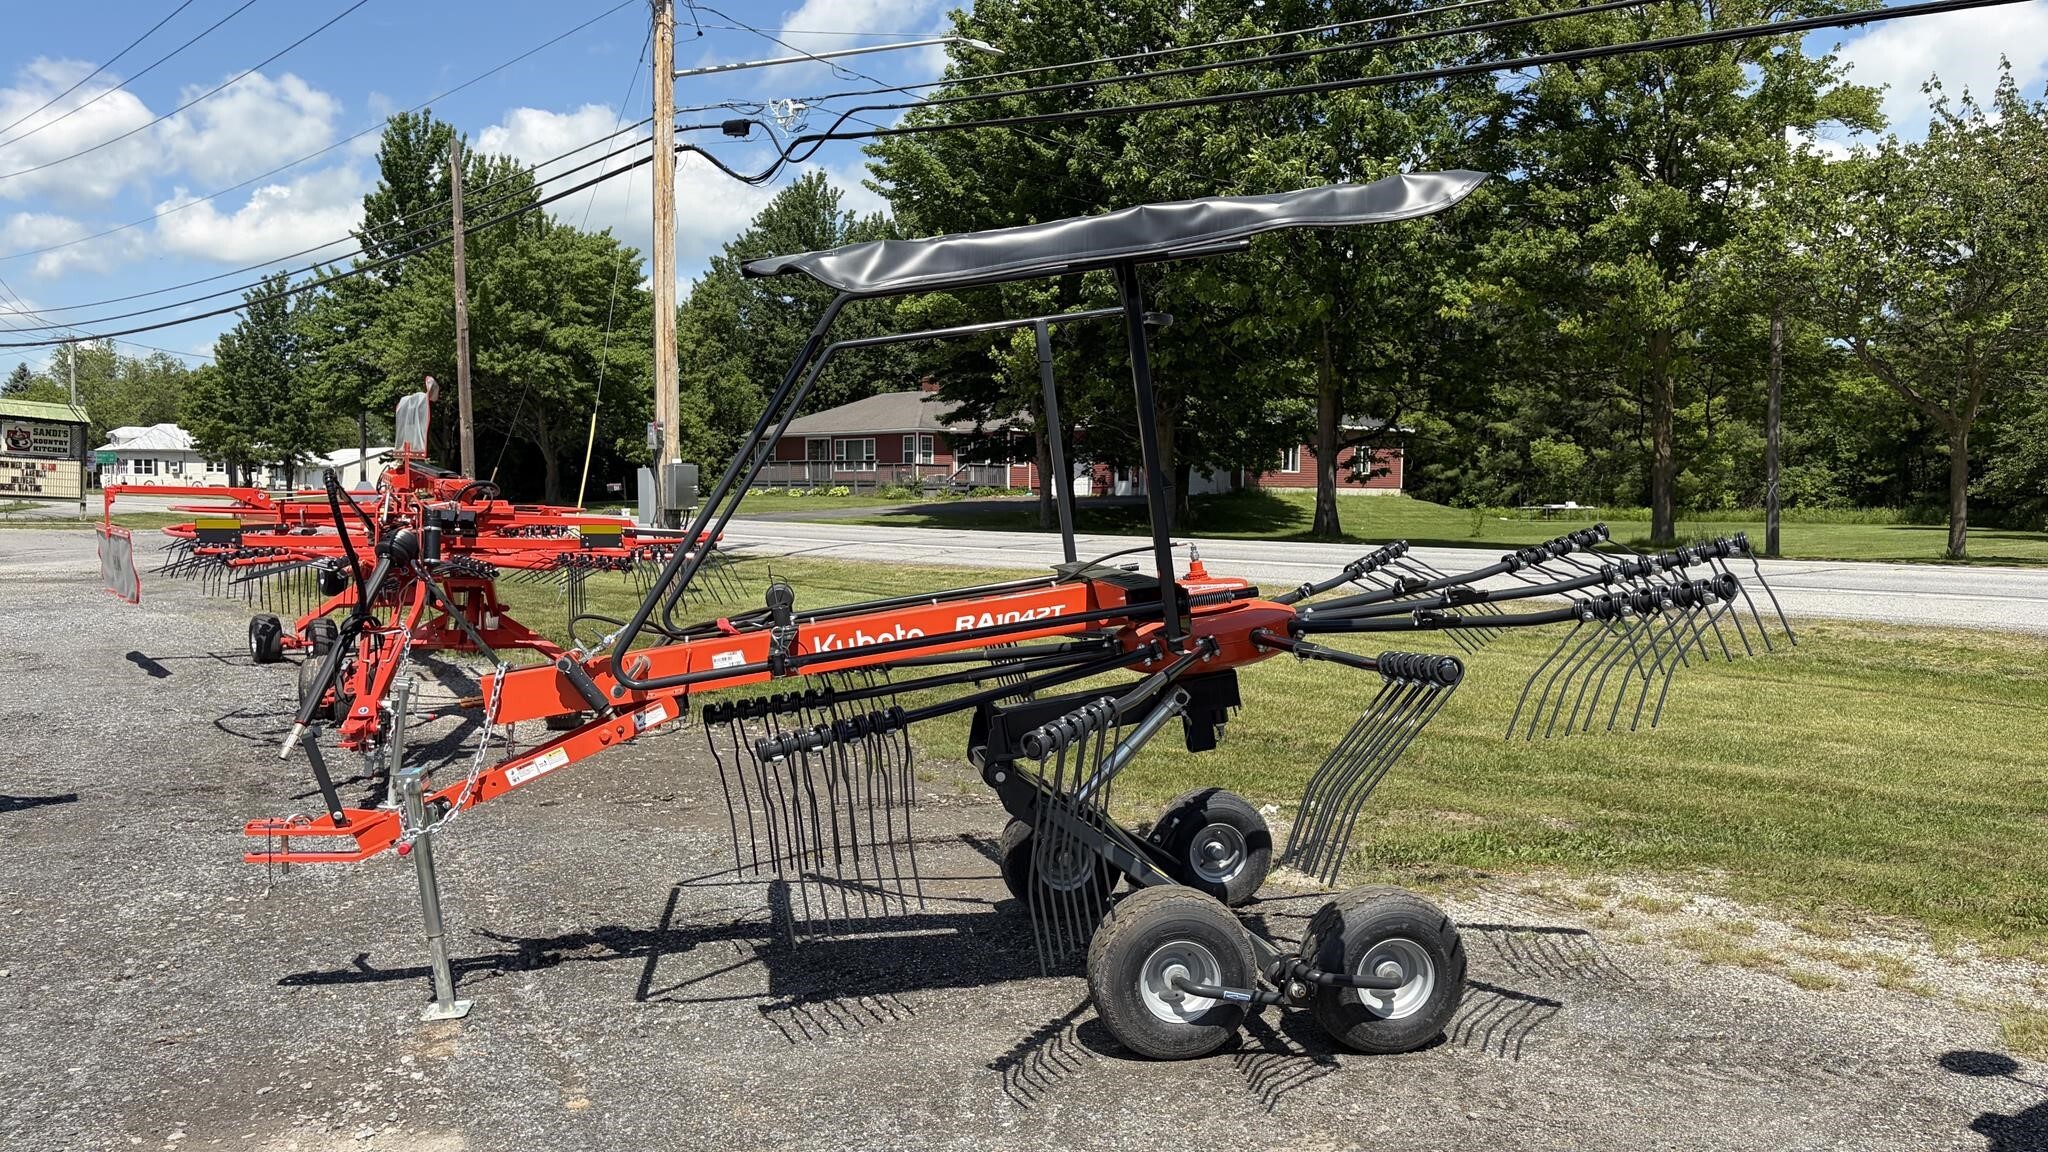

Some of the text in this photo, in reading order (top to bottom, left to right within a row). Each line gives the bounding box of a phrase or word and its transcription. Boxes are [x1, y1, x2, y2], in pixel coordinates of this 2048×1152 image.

[33, 428, 69, 438] SANDI'S
[33, 438, 69, 447] KOUNTRY
[955, 604, 1066, 631] RA1042T
